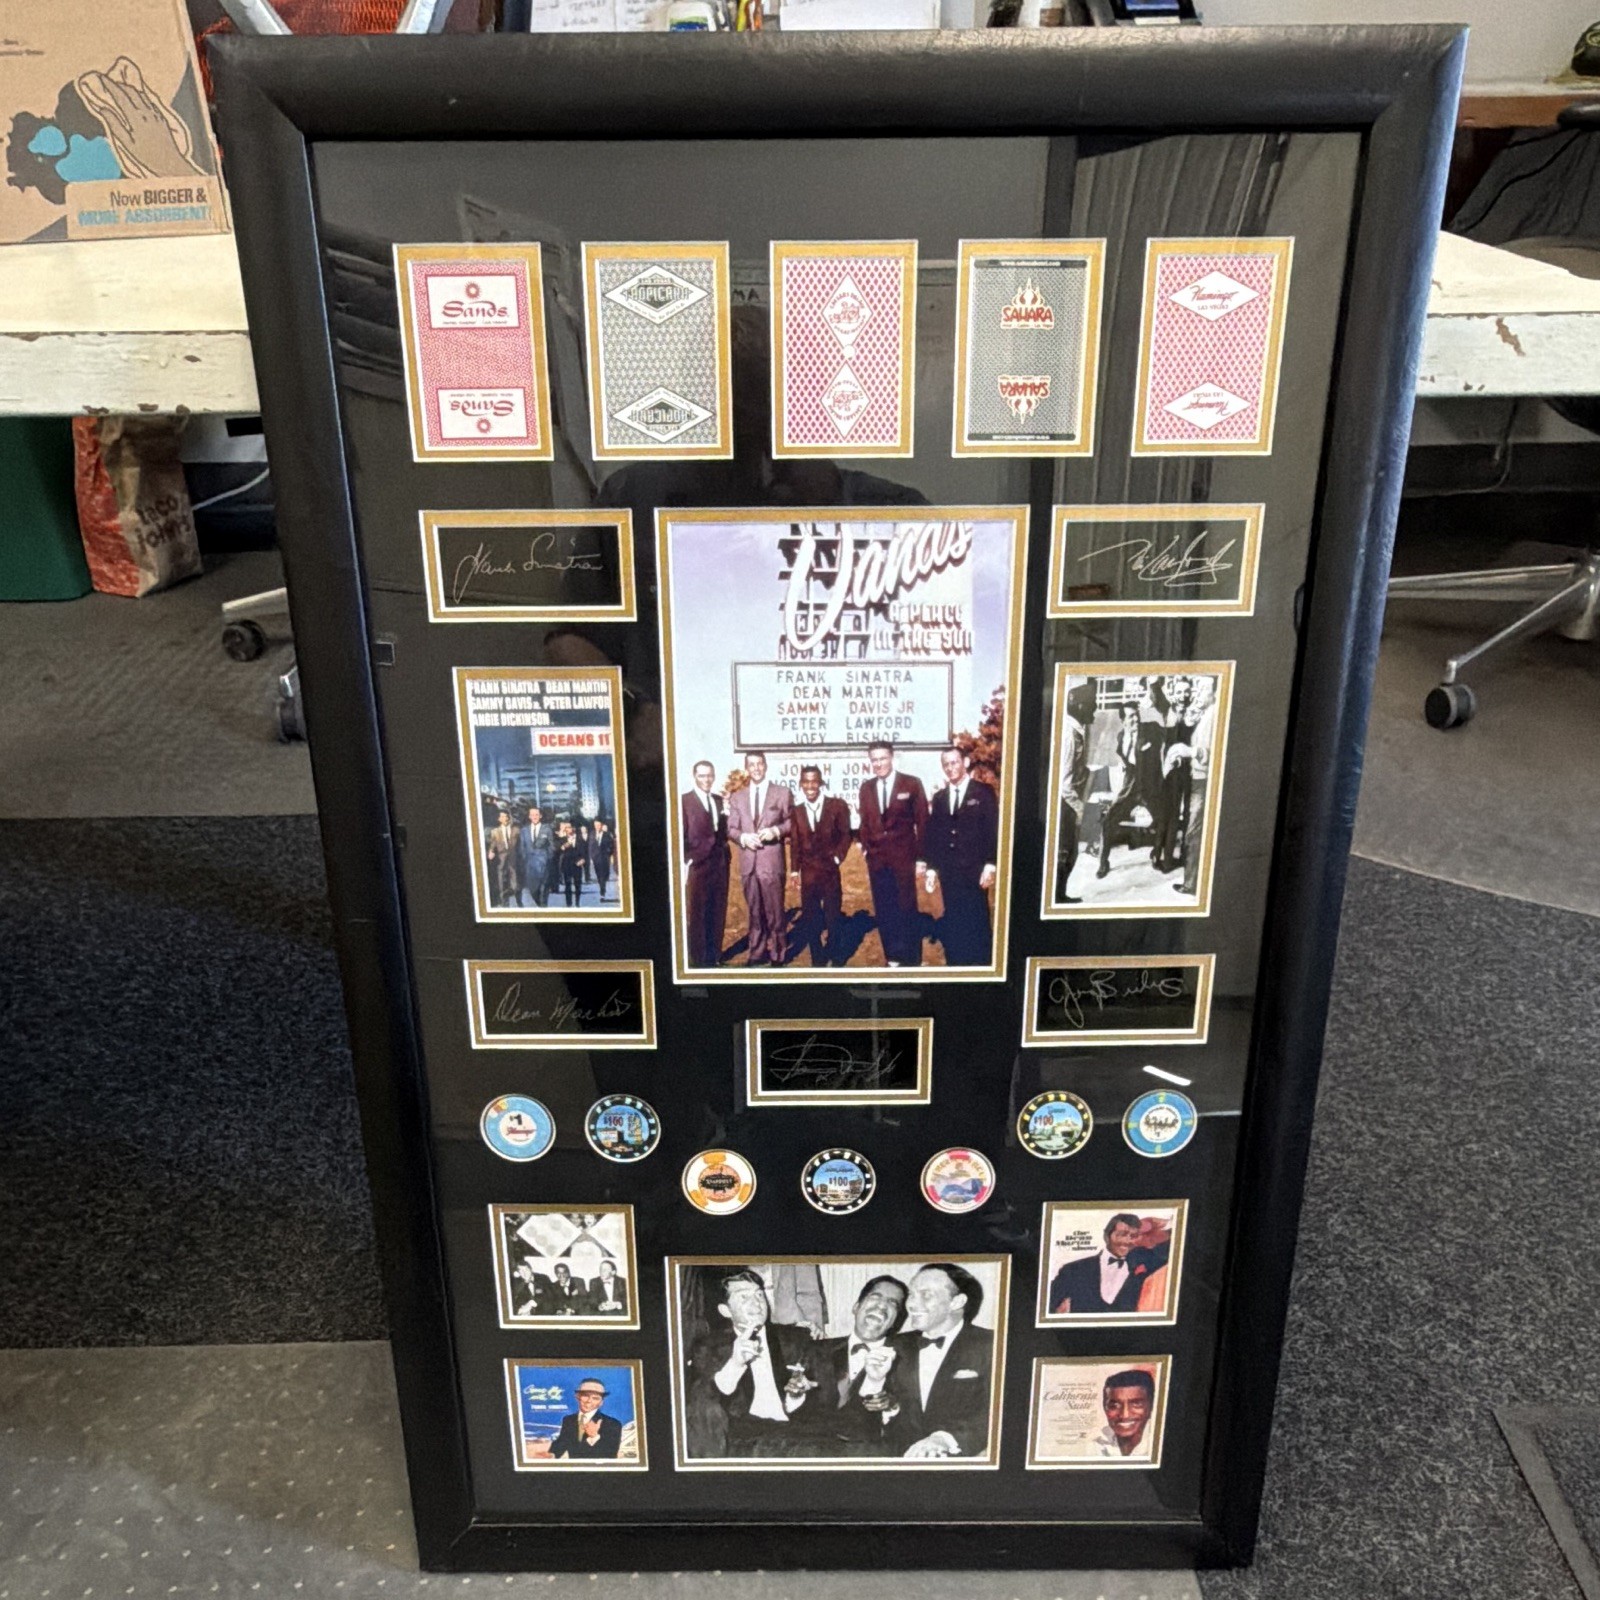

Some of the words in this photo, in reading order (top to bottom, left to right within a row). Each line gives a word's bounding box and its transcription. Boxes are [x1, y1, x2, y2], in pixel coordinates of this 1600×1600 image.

[110, 190, 141, 207] Now
[144, 188, 193, 205] BIGGER
[196, 187, 207, 202] &
[442, 300, 509, 318] Sands
[1002, 306, 1053, 322] SAHARA
[999, 382, 1049, 397] SAHARA
[450, 400, 515, 417] Sands
[776, 670, 826, 684] FRANK
[845, 670, 913, 683] SINATRA
[501, 680, 541, 694] SINATRA
[546, 680, 571, 694] DEAN
[572, 680, 608, 694] MARTIN
[793, 685, 832, 699] DEAN
[842, 685, 898, 699] MARTIN
[471, 696, 503, 710] SAMMY
[505, 696, 532, 710] DAVIS
[543, 696, 571, 709] PETER
[777, 702, 829, 715] SAMMY
[849, 701, 889, 714] DAVIS
[897, 701, 914, 713] JR
[500, 712, 550, 726] DICKINSON
[781, 717, 827, 730] PETER
[846, 716, 913, 729] LAWFORD
[795, 732, 827, 744] JOEY
[846, 732, 900, 743] BISHOP
